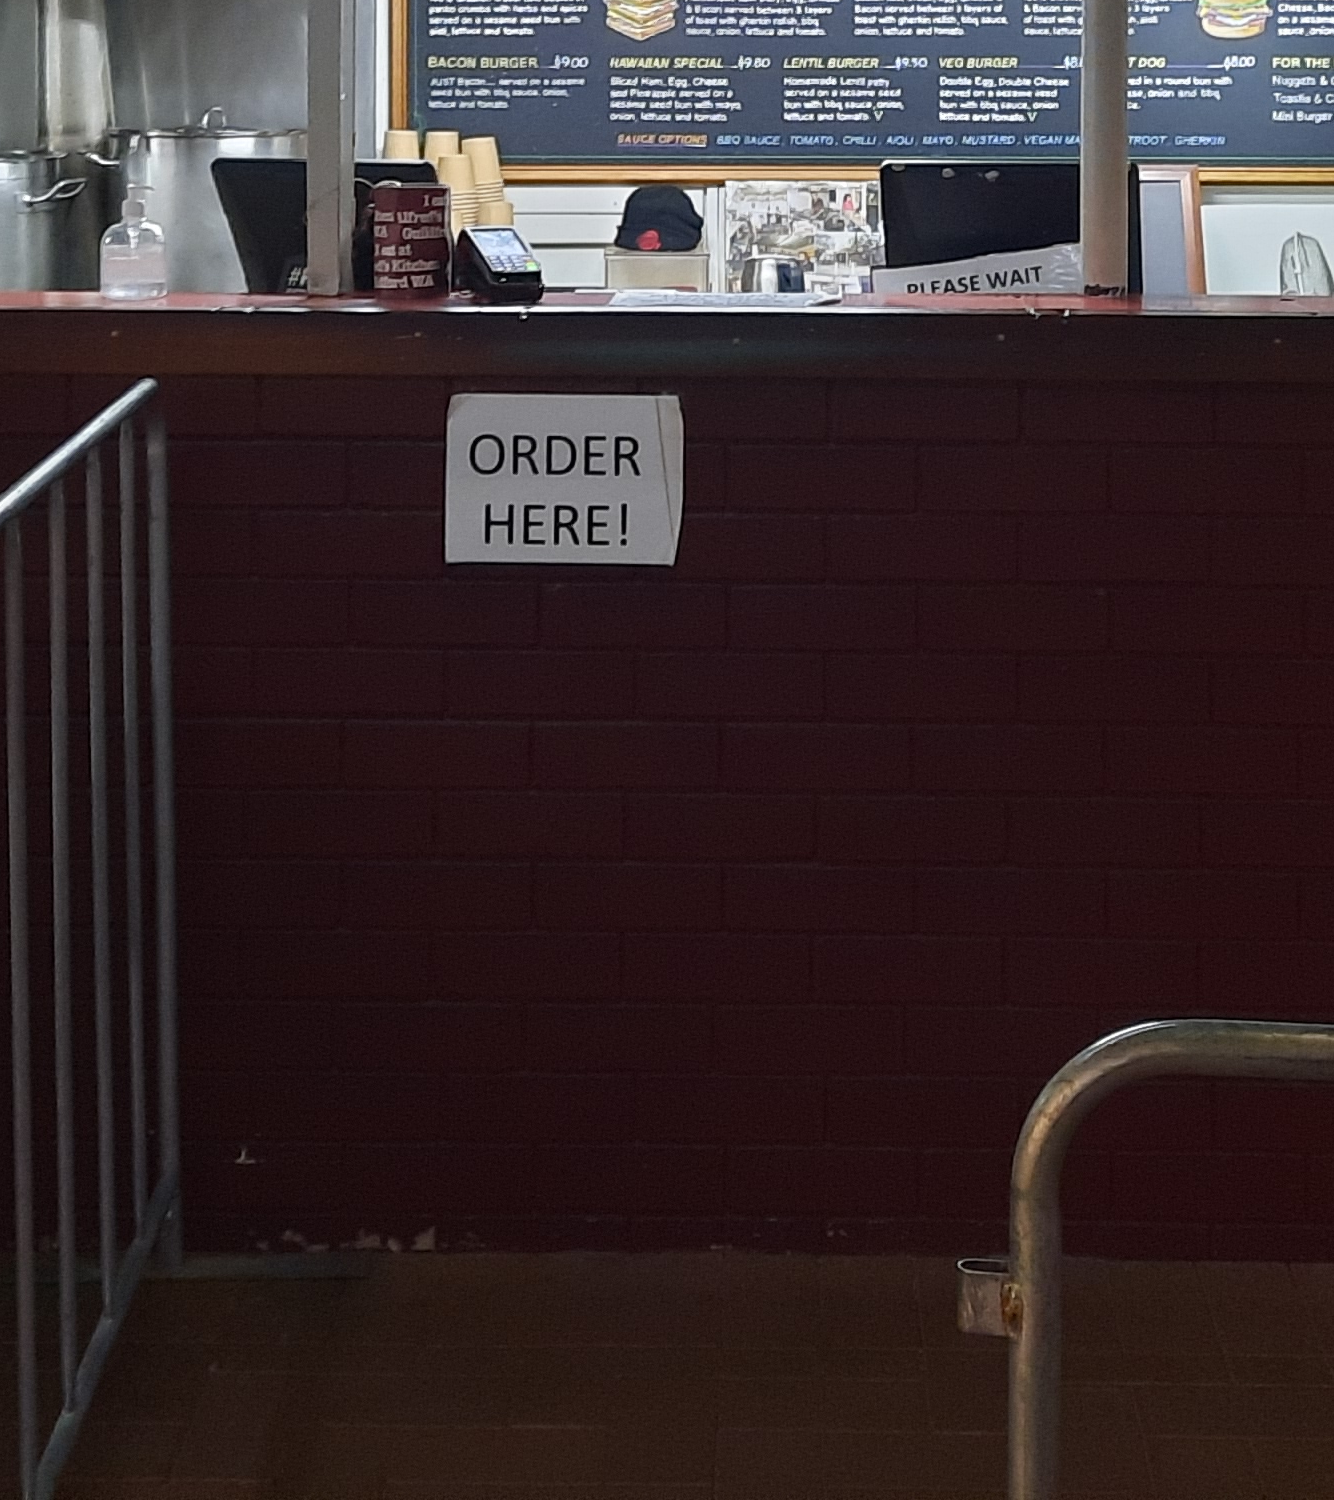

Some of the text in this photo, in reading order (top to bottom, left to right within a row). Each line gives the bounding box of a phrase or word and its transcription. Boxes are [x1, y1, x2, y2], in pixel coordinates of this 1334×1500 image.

[427, 57, 476, 69] BACON
[480, 57, 539, 69] BURGER
[610, 57, 669, 69] HAWAIIAN
[673, 57, 724, 69] SPECIAL
[783, 58, 825, 69] LENTIL
[827, 57, 879, 69] BURGER
[939, 58, 963, 68] VEG
[966, 58, 1018, 68] BURGER
[1138, 57, 1166, 68] DOG
[1272, 58, 1301, 68] FOR
[1305, 58, 1330, 68] THE
[1272, 76, 1316, 87] Nuggets
[1320, 76, 1328, 86] &
[1272, 111, 1294, 121] Mini
[1297, 111, 1333, 123] Burger
[618, 135, 656, 144] SAUCE
[658, 135, 707, 144] OPTIONS
[1024, 136, 1062, 145] VEGAN
[986, 266, 1043, 289] WAIT
[469, 434, 641, 476] ORDER
[485, 503, 627, 546] HERE!
